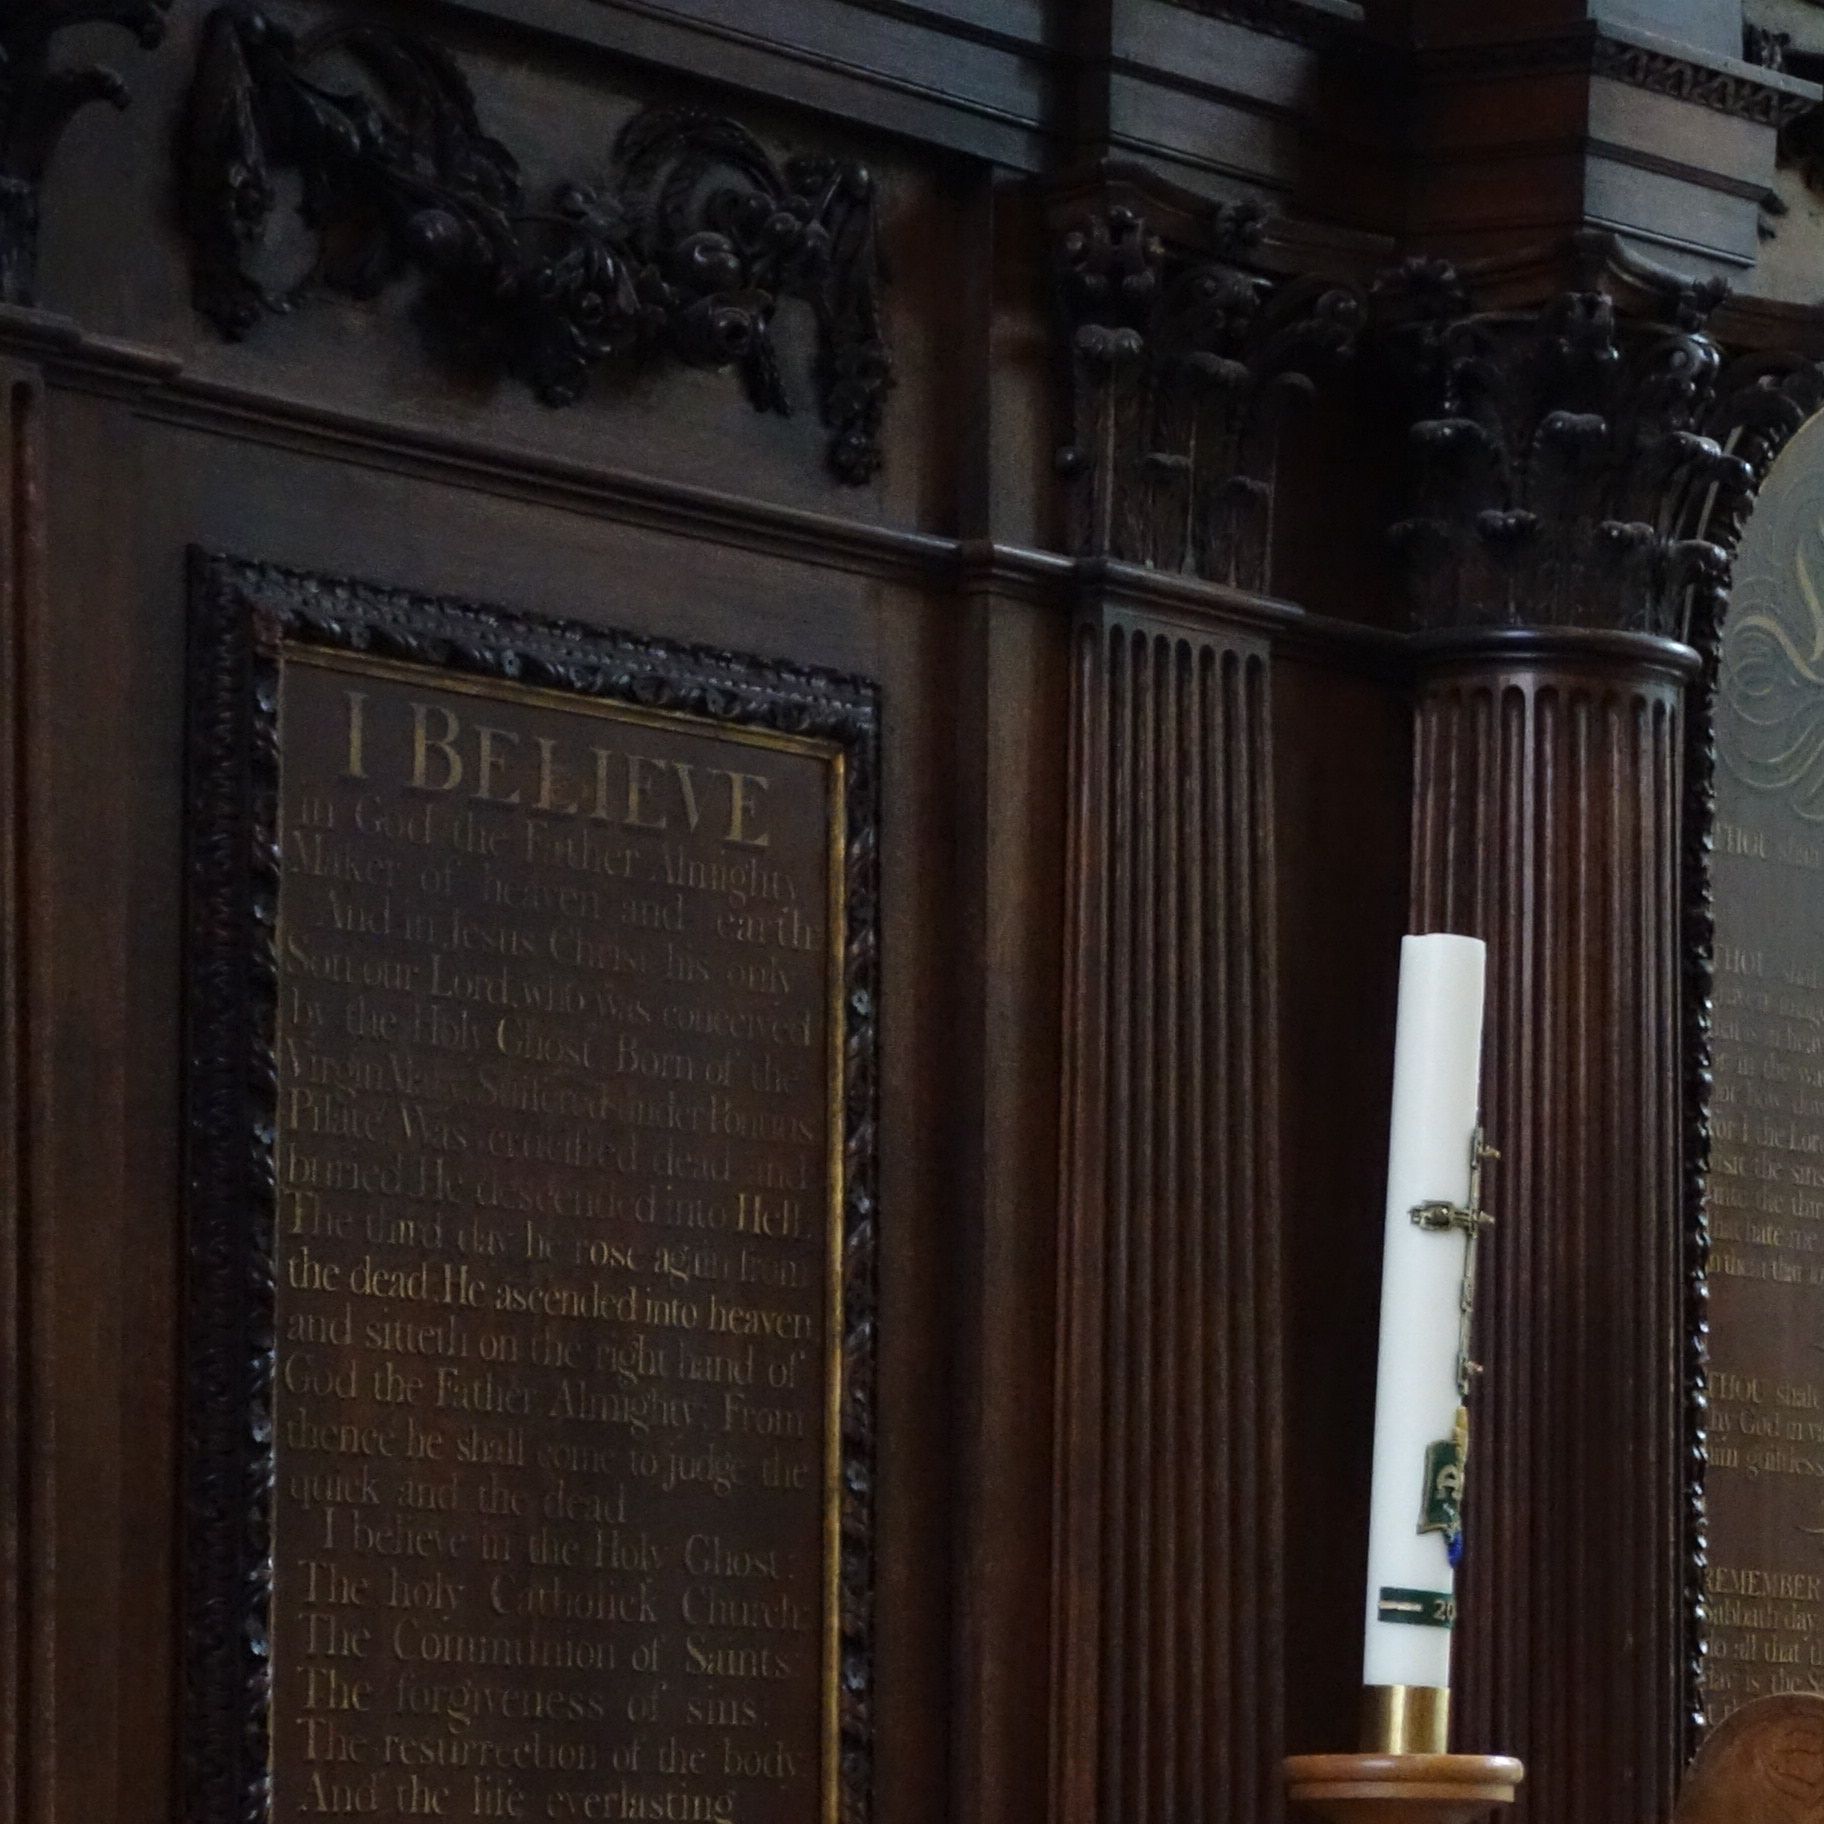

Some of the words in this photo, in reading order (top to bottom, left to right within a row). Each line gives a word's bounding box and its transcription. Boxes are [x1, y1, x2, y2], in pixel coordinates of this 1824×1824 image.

[342, 691, 371, 779] I
[404, 702, 770, 847] BELIEVE
[355, 794, 433, 845] God
[617, 1034, 694, 1081] Born
[574, 1238, 642, 1271] rose
[289, 1245, 341, 1291] the
[442, 1263, 485, 1307] He
[496, 1281, 637, 1322] ascended
[644, 1286, 698, 1329] into
[707, 1294, 813, 1339] heaven
[286, 1302, 352, 1345] and
[365, 1306, 468, 1357] sitteth
[478, 1333, 518, 1363] on
[530, 1325, 583, 1369] the
[597, 1333, 668, 1390] right
[678, 1339, 753, 1385] hand
[768, 1350, 806, 1389] of
[284, 1351, 357, 1398] God
[374, 1361, 424, 1405] the
[435, 1366, 538, 1415] Father
[724, 1391, 803, 1436] From
[1739, 1409, 1781, 1437] God
[287, 1407, 394, 1456] thence
[406, 1416, 444, 1460] he
[456, 1424, 525, 1467] shall
[630, 1448, 658, 1476] to
[662, 1438, 747, 1497] judge
[762, 1447, 808, 1488] the
[290, 1465, 380, 1509] quick
[398, 1472, 458, 1510] and
[478, 1471, 529, 1515] the
[323, 1507, 336, 1548] I
[353, 1508, 467, 1558] believe
[482, 1523, 511, 1561] in
[529, 1526, 580, 1567] the
[595, 1529, 668, 1571] Holy
[298, 1560, 369, 1606] The
[389, 1566, 465, 1619] holy
[491, 1572, 657, 1623] Catholick
[298, 1613, 371, 1657] The
[393, 1616, 615, 1670] Communion
[631, 1634, 667, 1672] of
[1764, 1633, 1800, 1663] that
[297, 1666, 370, 1711] The
[398, 1669, 605, 1735] forgiveness
[626, 1681, 668, 1723] of
[295, 1718, 368, 1763] The
[384, 1731, 597, 1770] resurrection
[612, 1736, 648, 1771] of
[658, 1736, 706, 1774] the
[298, 1771, 386, 1812] And
[397, 1774, 450, 1815] the
[473, 1774, 524, 1817] life
